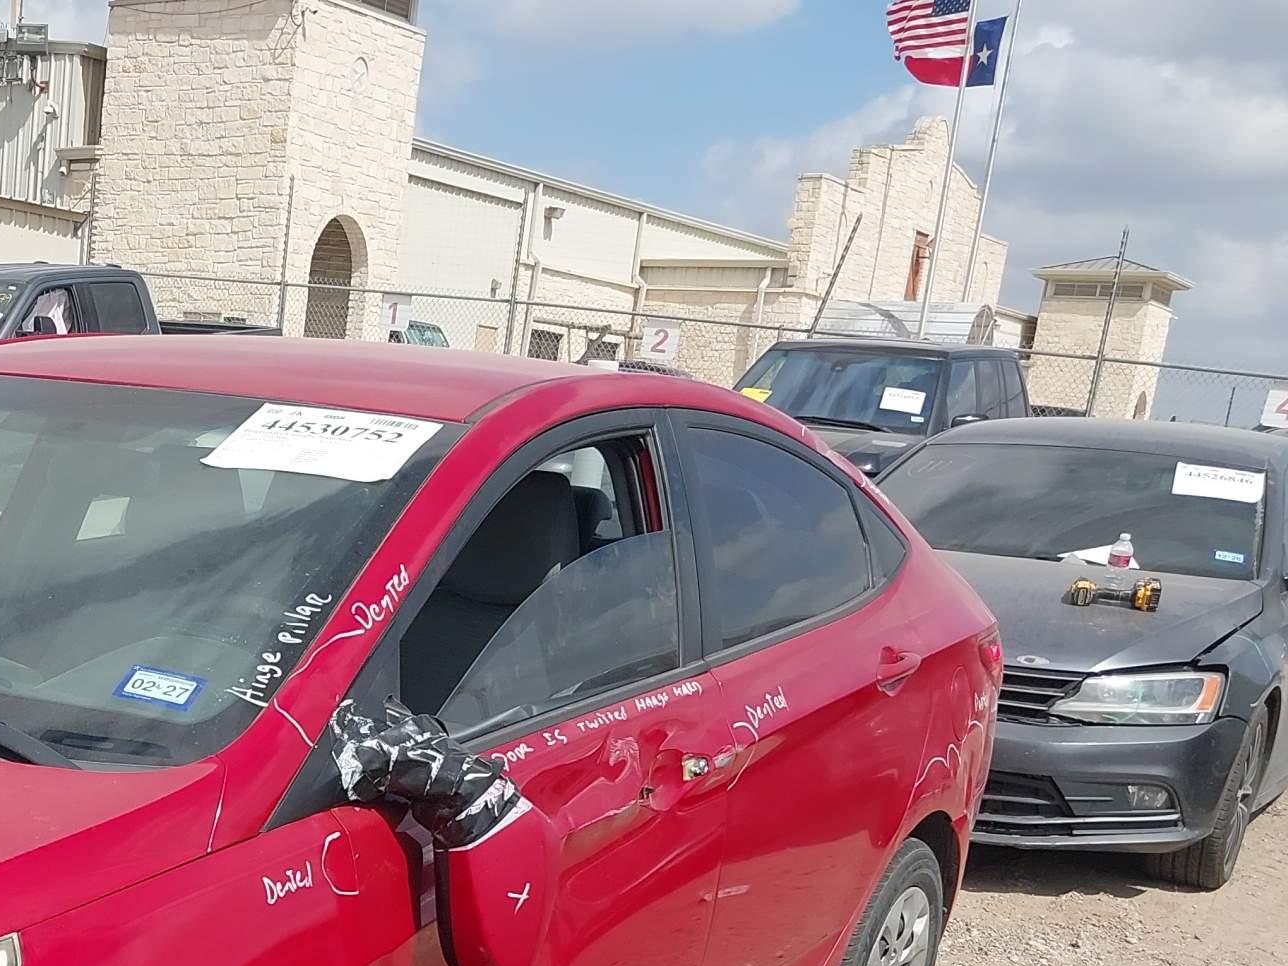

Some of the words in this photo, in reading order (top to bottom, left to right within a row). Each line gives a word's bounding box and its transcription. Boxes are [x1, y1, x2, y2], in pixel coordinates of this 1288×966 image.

[650, 328, 670, 353] 2
[261, 418, 404, 444] 44530752
[224, 651, 282, 708] Hinge
